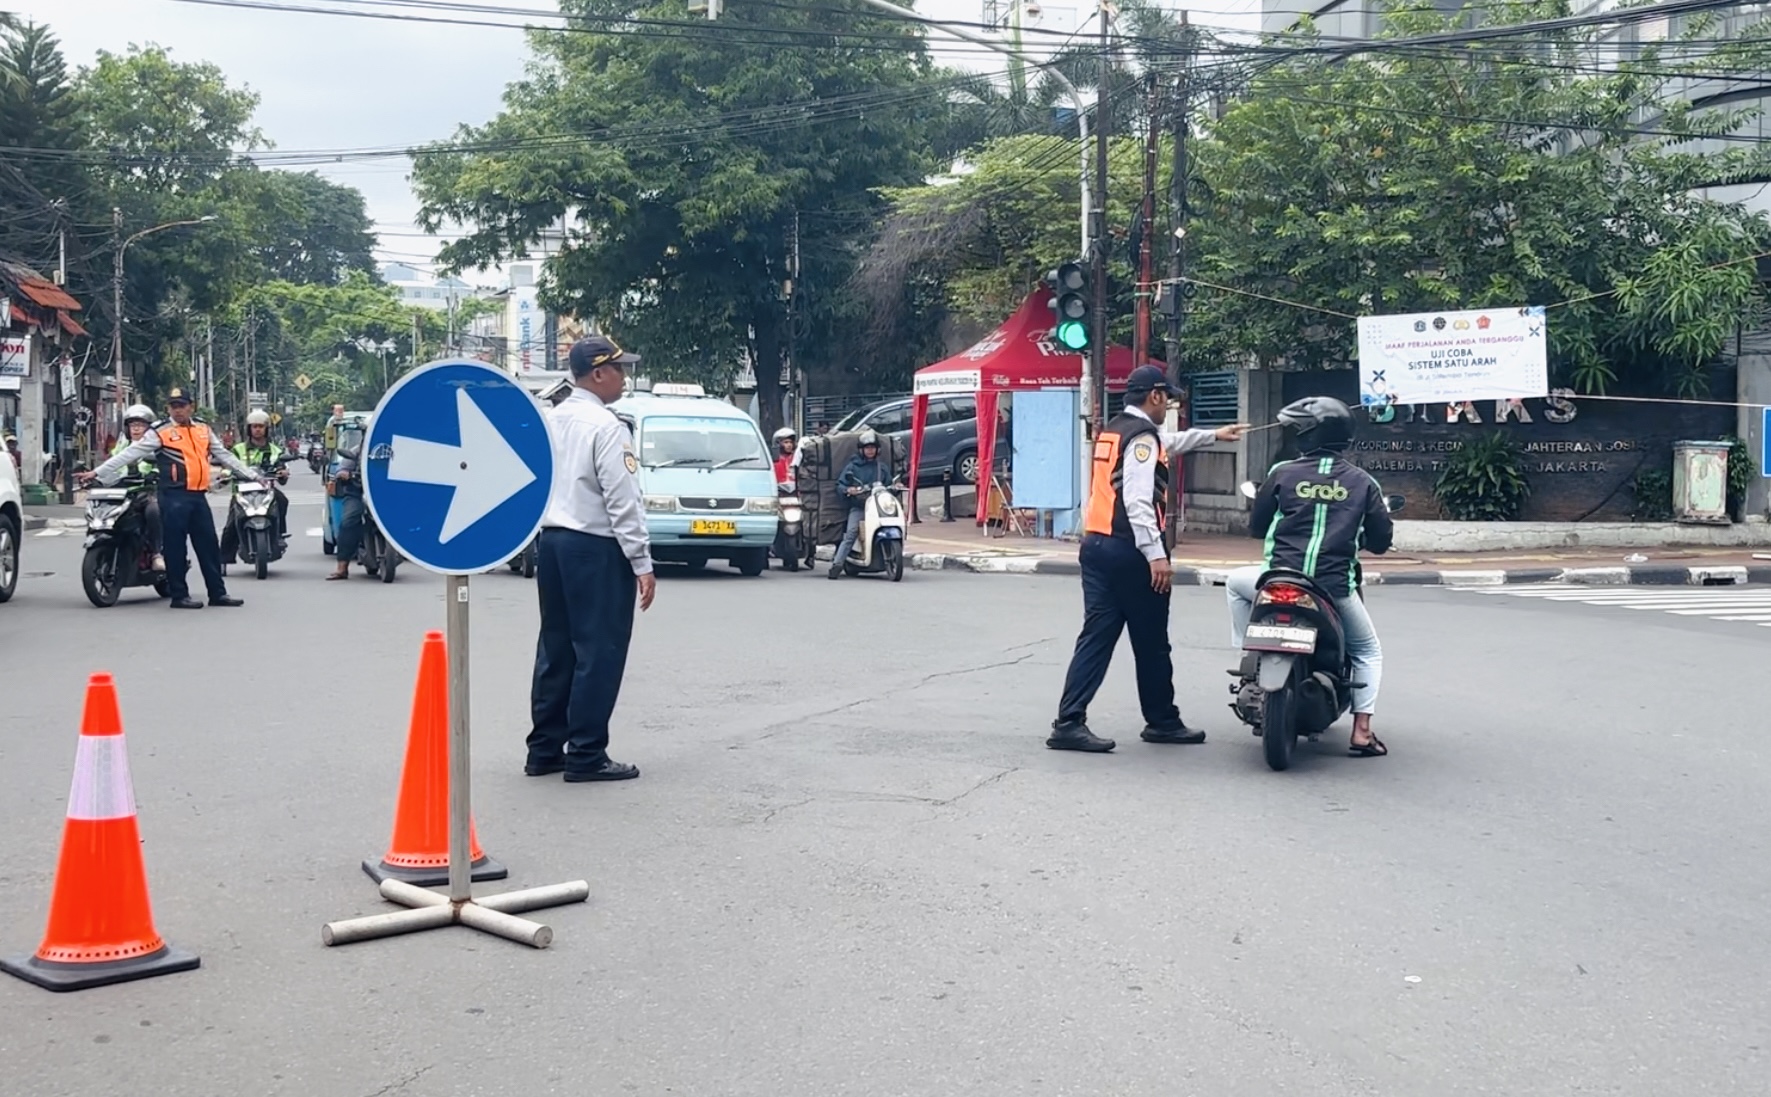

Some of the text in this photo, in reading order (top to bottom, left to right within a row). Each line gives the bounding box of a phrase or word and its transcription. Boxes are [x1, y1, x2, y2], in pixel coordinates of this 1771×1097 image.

[1407, 340, 1454, 349] PERJALANAN
[1455, 338, 1477, 346] ANDA
[1478, 335, 1525, 344] TERGANGGU
[1430, 348, 1474, 359] UJI COBA
[1408, 356, 1497, 370] SISTEM SATU ARAH
[1368, 460, 1423, 471] SALEMBA
[1537, 461, 1607, 472] JAKARTA
[1295, 480, 1348, 501] Grab
